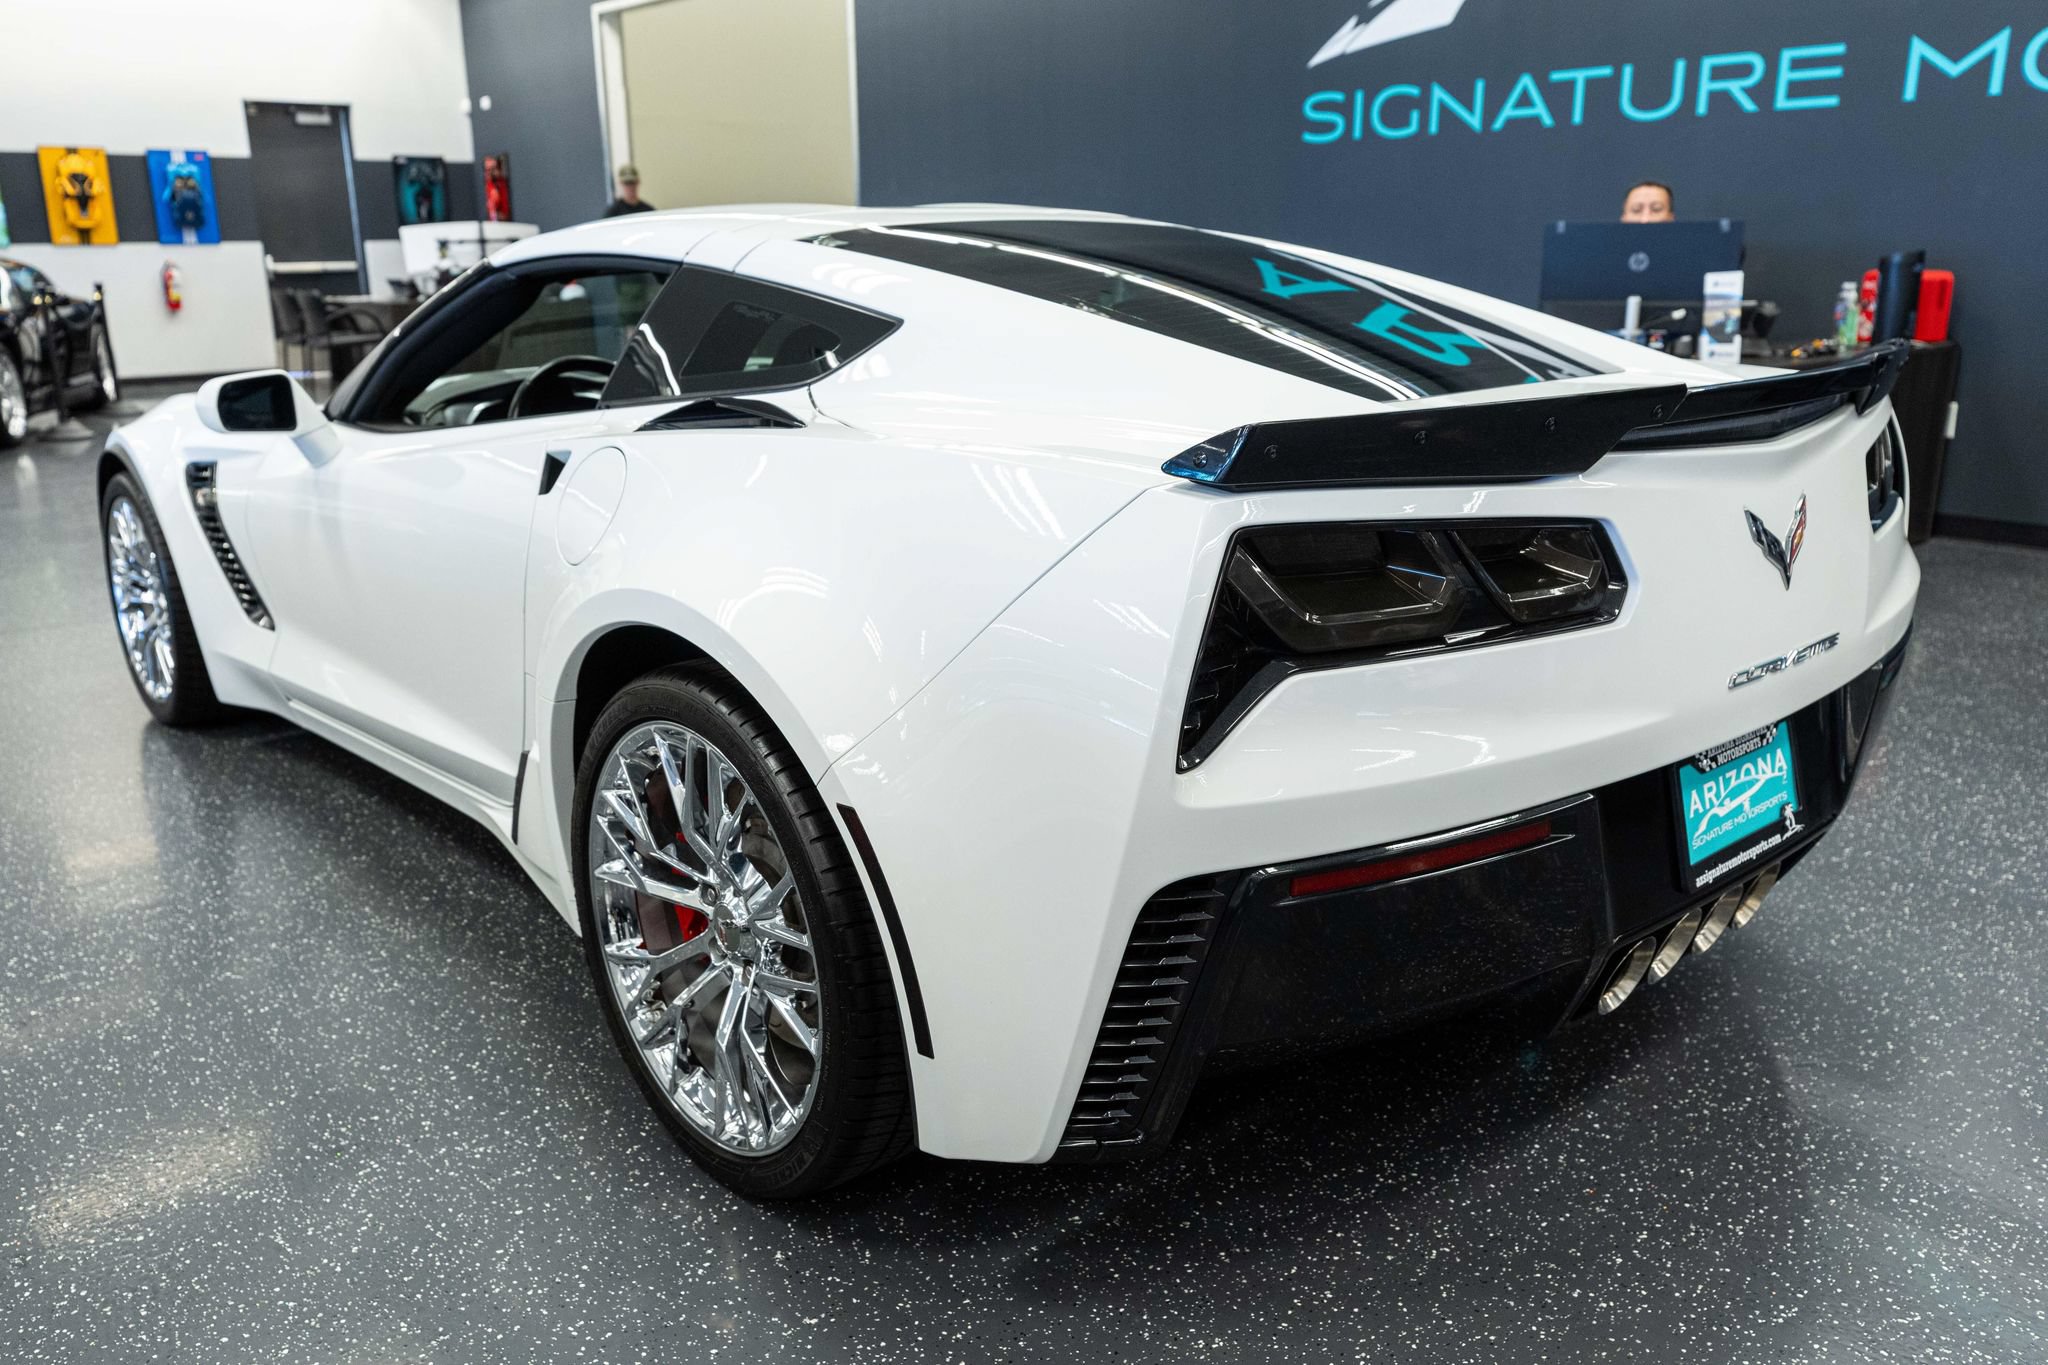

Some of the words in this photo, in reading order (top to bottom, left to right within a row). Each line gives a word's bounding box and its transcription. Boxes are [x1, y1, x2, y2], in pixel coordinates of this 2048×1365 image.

[1301, 42, 1848, 145] SIGNATURE
[1717, 737, 1762, 766] MOTORSPORTS
[1688, 748, 1788, 819] ARIZONA
[1691, 820, 1735, 850] SIGNATURE
